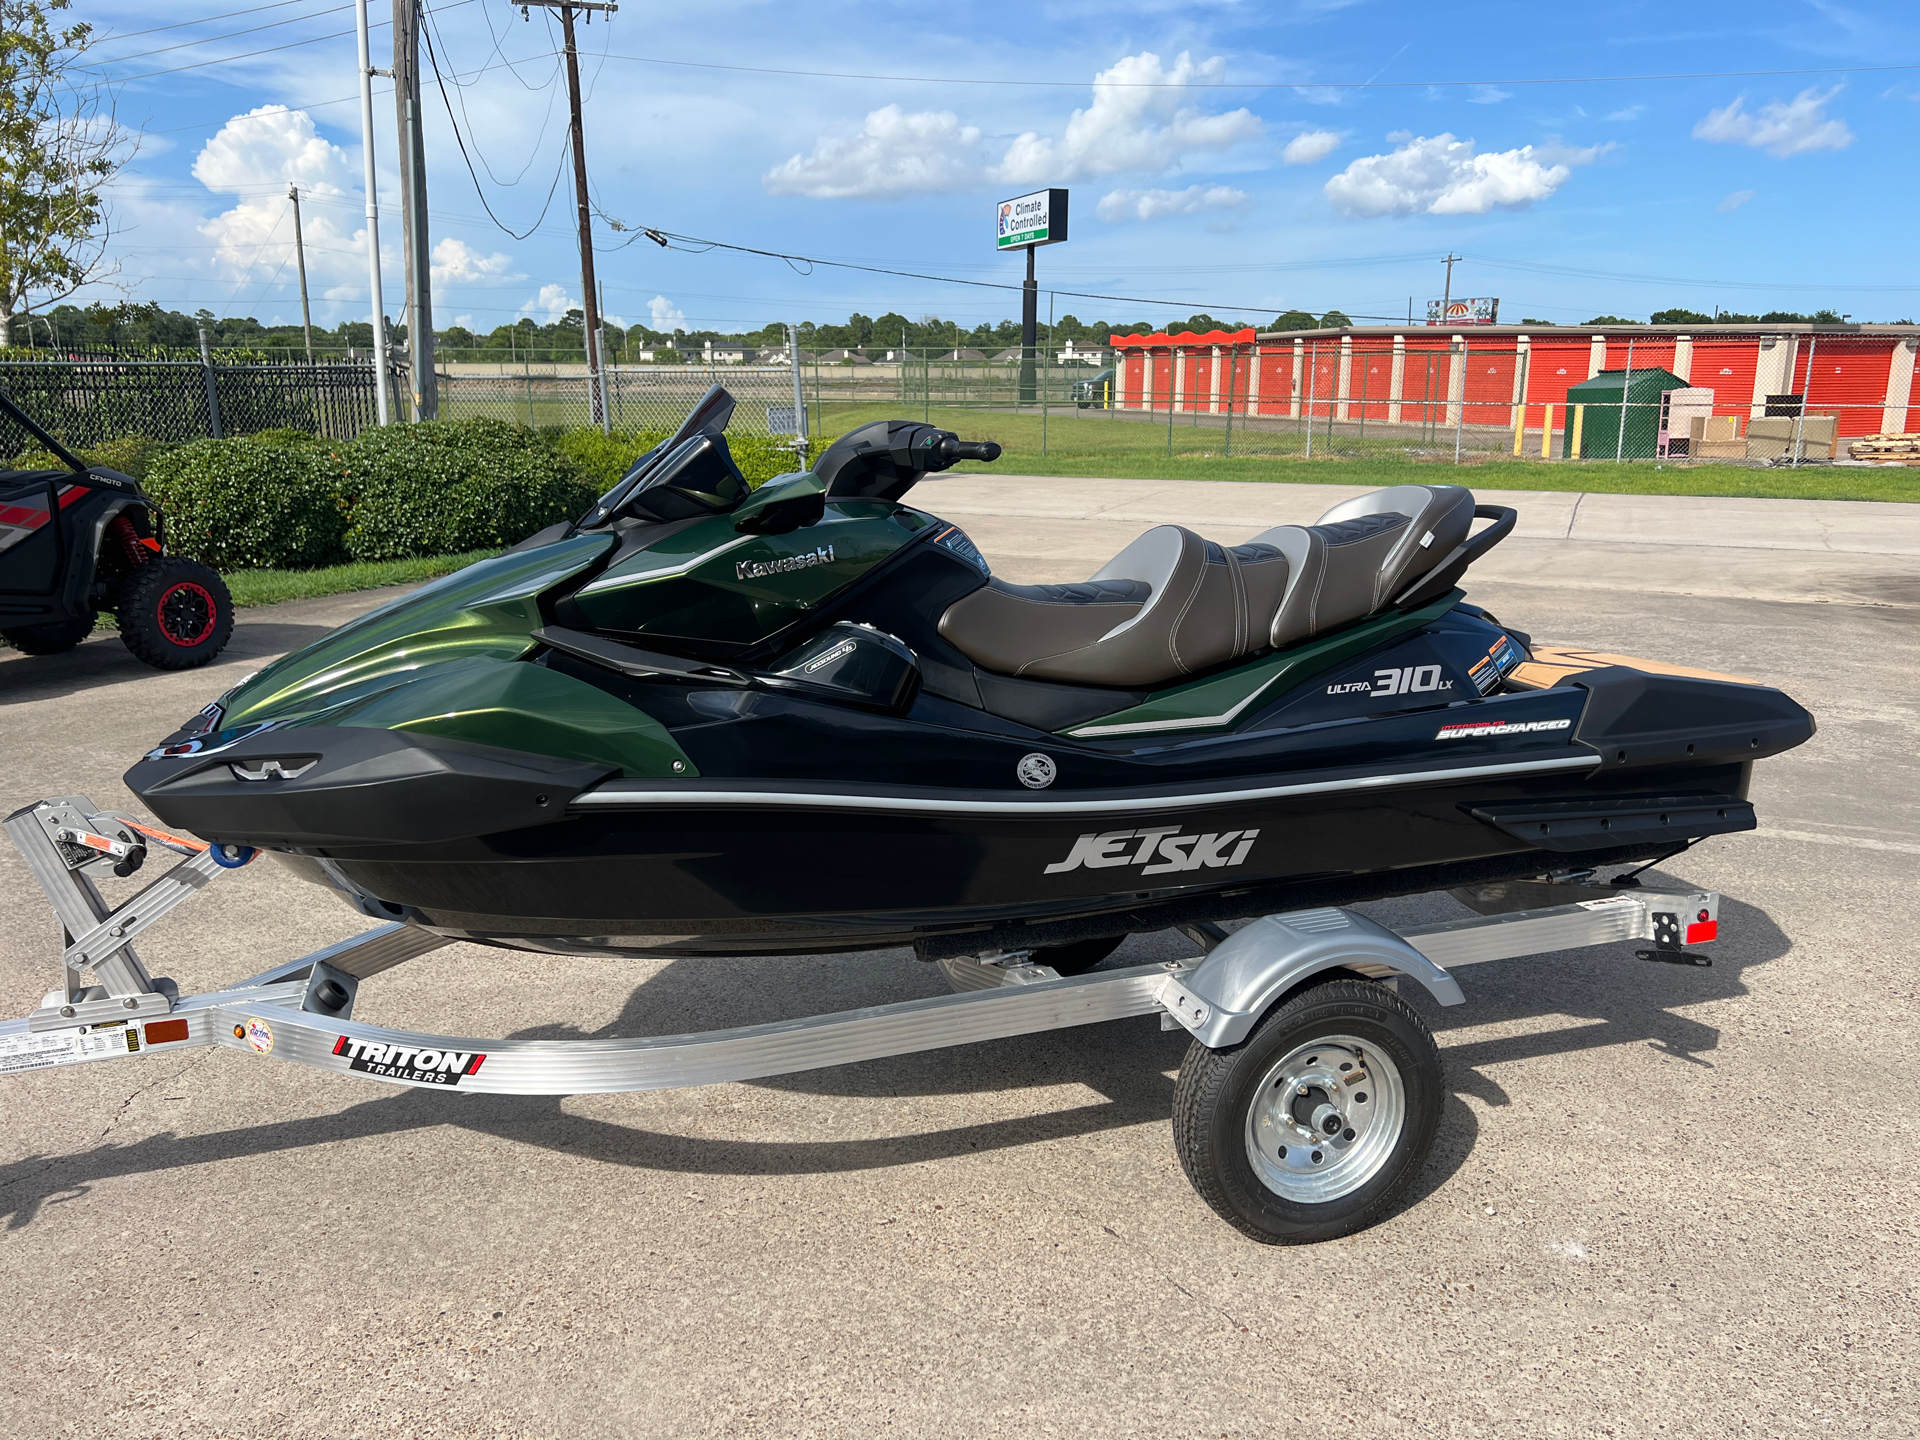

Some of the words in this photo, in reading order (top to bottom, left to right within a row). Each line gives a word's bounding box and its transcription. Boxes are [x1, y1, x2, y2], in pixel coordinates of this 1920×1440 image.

[1015, 200, 1041, 216] Climate
[1010, 211, 1047, 231] Controlled
[1010, 234, 1021, 243] OPEN
[1024, 231, 1035, 240] DAYS
[90, 473, 122, 487] CFMOTO
[735, 544, 835, 580] Kawasaki
[1326, 681, 1372, 695] ULTRA
[1370, 664, 1443, 698] 310
[1439, 679, 1454, 691] LX
[1435, 719, 1571, 740] SUPERCHARGED
[1441, 720, 1506, 731] INTERCOOLED
[346, 1037, 472, 1074] TRITON
[366, 1062, 447, 1084] TRAILERS
